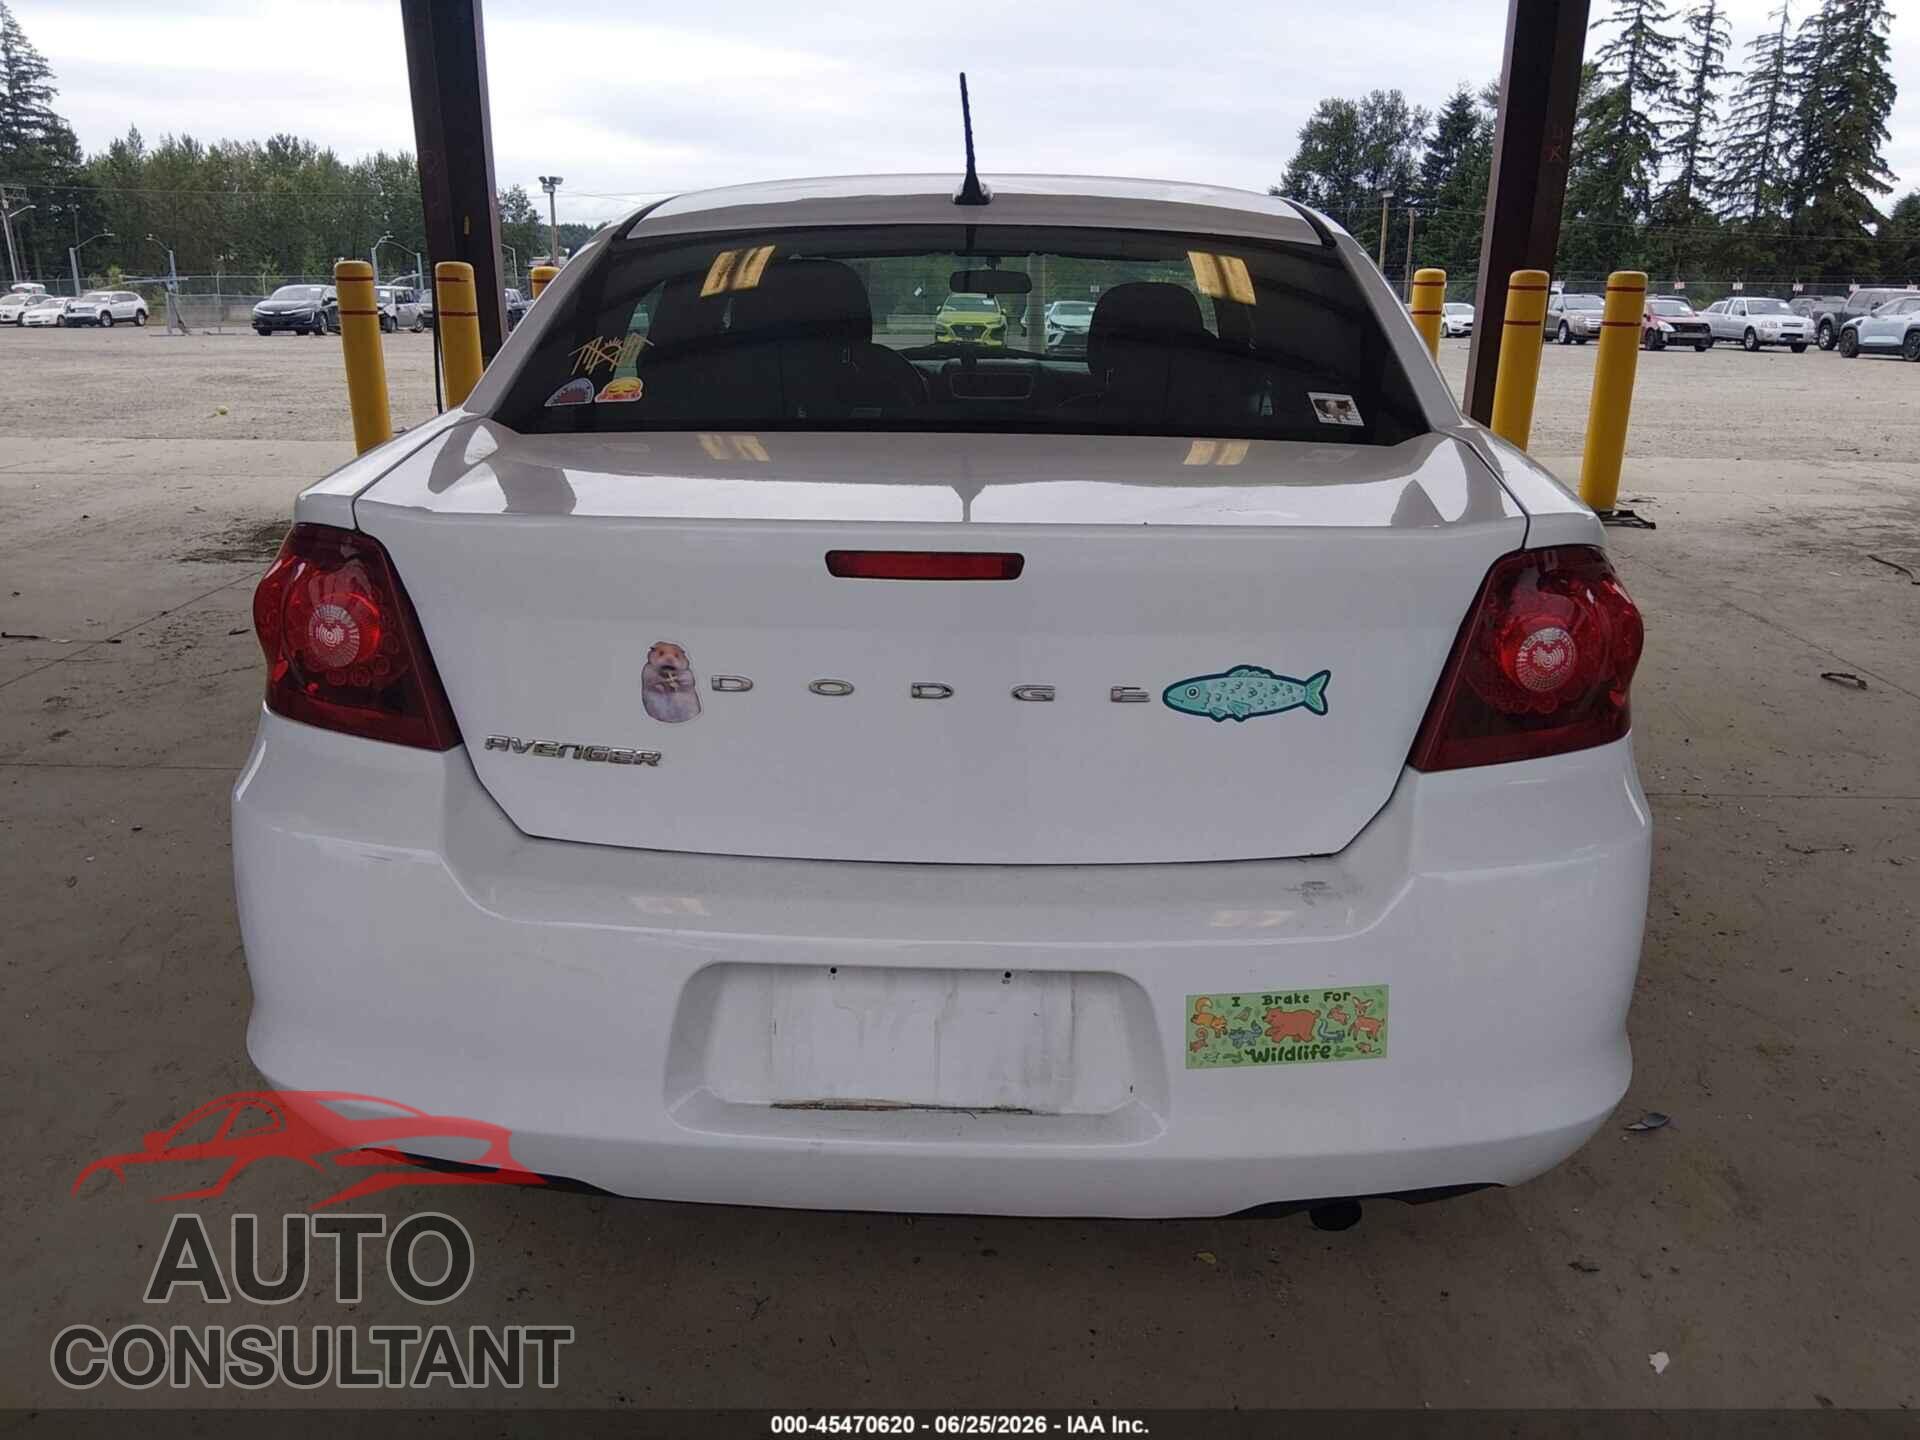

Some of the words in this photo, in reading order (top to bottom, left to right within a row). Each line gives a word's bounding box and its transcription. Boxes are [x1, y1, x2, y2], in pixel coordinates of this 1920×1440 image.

[711, 674, 1151, 702] DODGE
[485, 734, 662, 767] AVENGER
[1231, 996, 1240, 1007] I
[1261, 993, 1310, 1006] Brake
[1245, 1043, 1331, 1063] Wildlife
